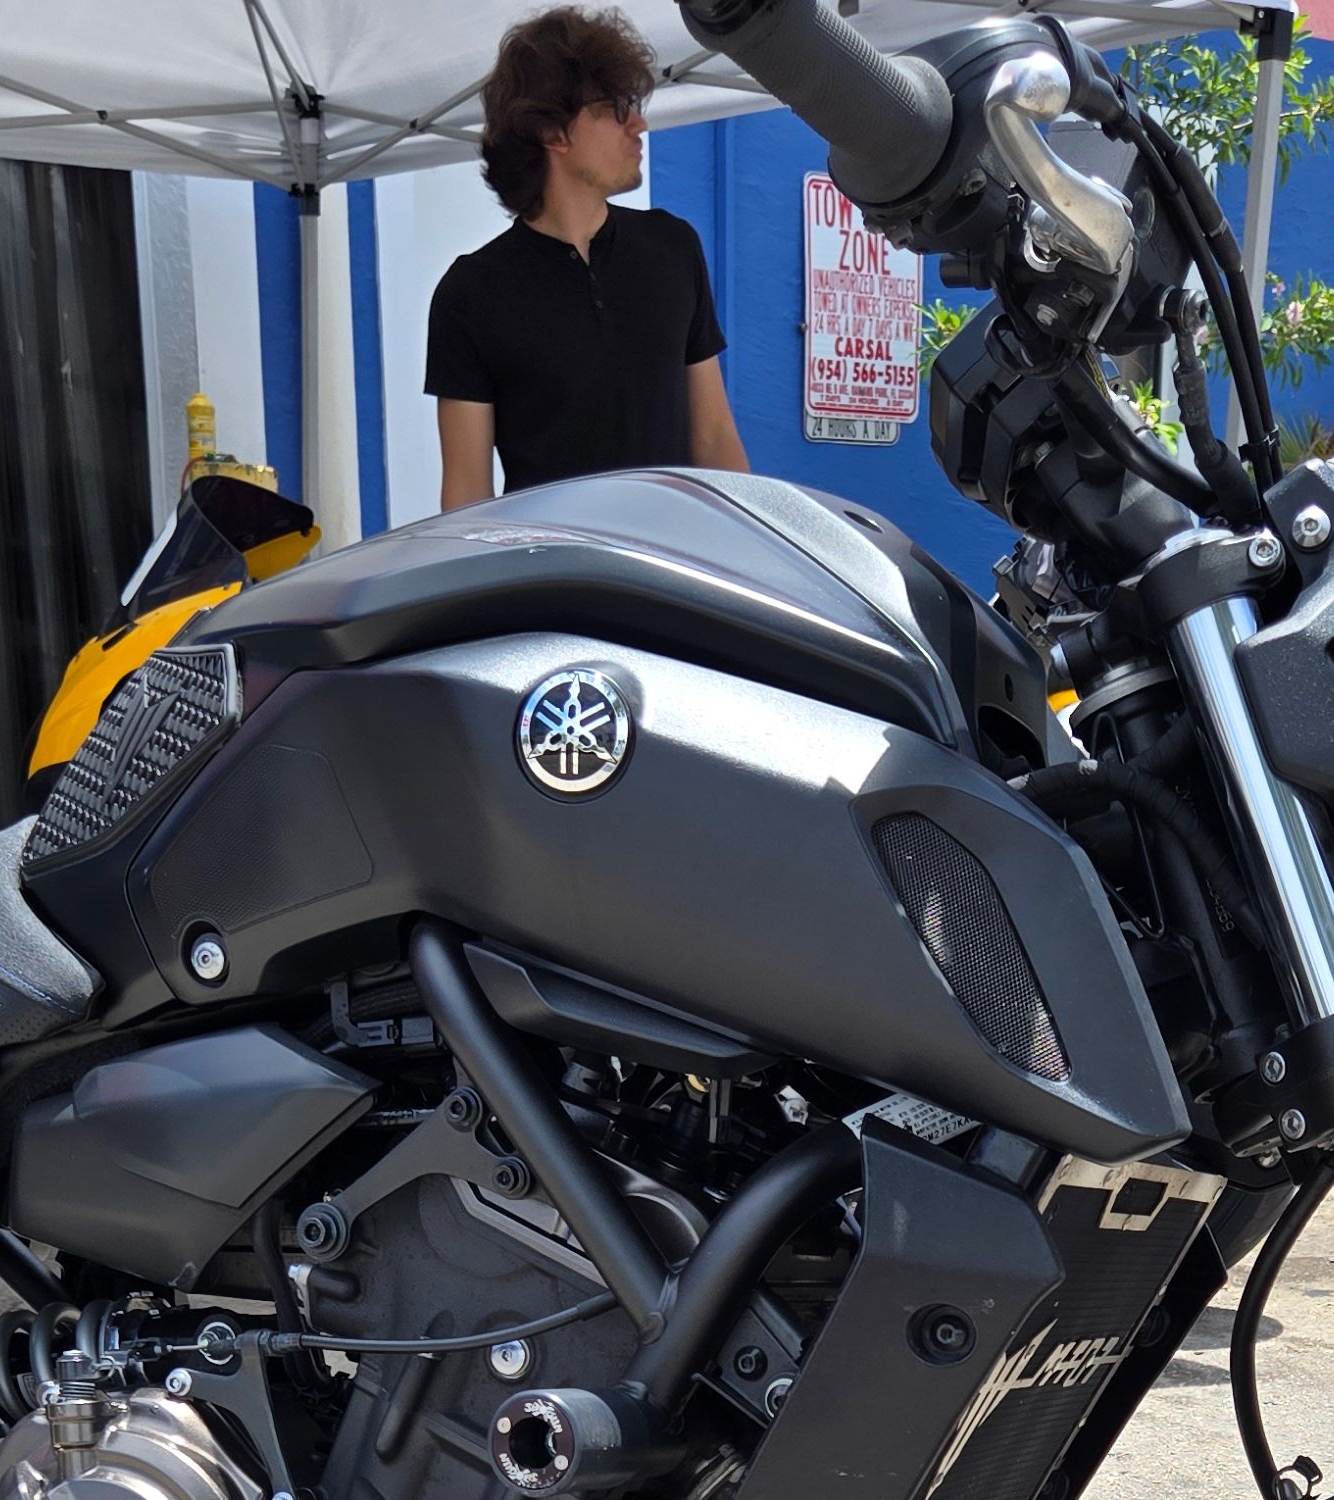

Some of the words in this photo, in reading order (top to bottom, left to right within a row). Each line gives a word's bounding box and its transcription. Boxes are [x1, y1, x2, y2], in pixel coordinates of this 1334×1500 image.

[839, 230, 891, 276] ZONE
[878, 277, 915, 300] VEHICLES
[814, 313, 824, 334] 24
[835, 336, 892, 362] CARSAL
[812, 357, 847, 384] (954)
[853, 362, 915, 387] 566-5155
